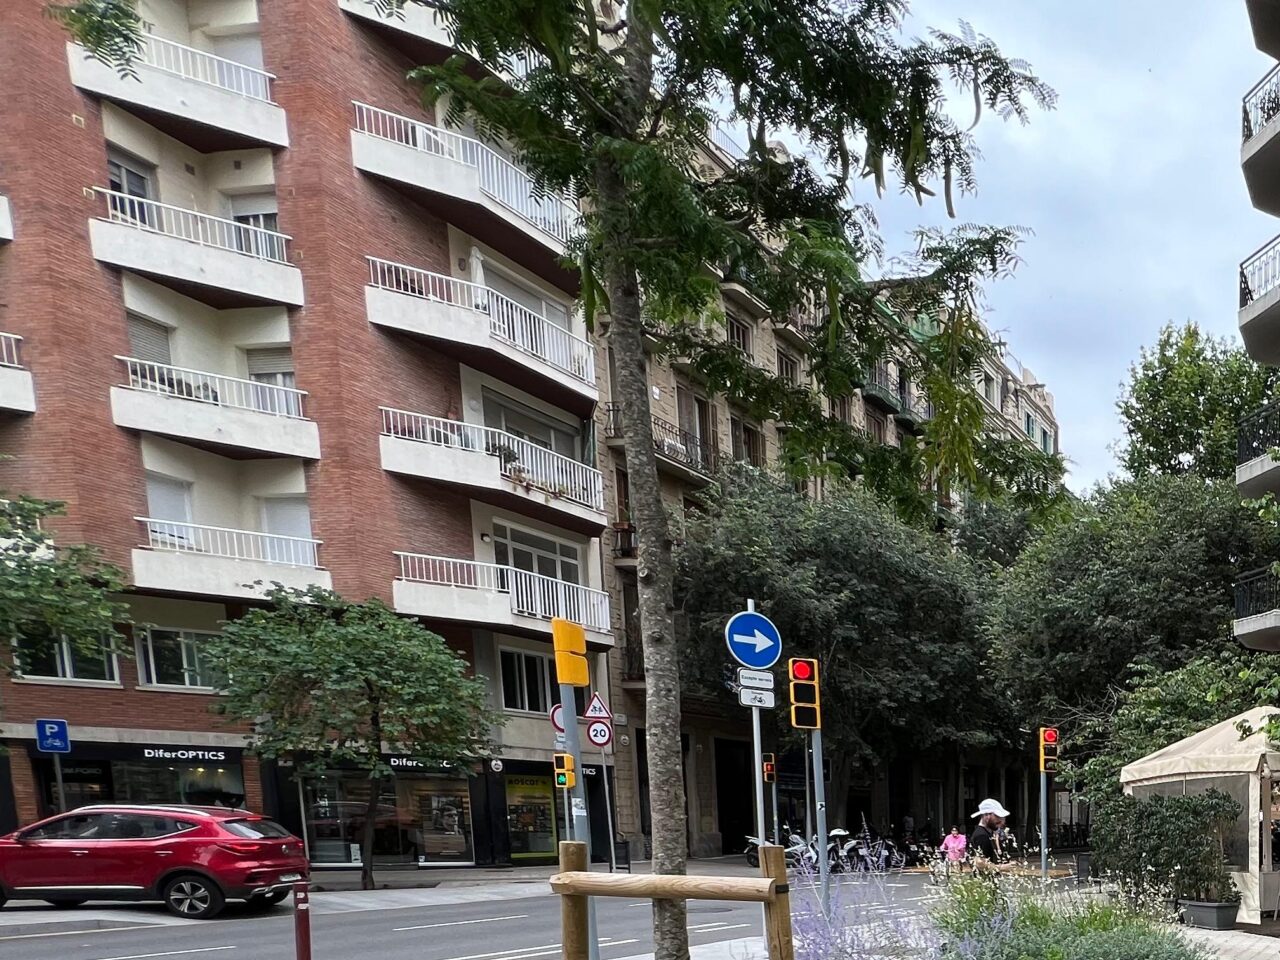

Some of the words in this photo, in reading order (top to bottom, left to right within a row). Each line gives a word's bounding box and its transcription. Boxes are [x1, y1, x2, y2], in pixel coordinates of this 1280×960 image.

[45, 723, 59, 736] P
[592, 728, 607, 738] 20
[144, 749, 226, 761] DiferOPTICS
